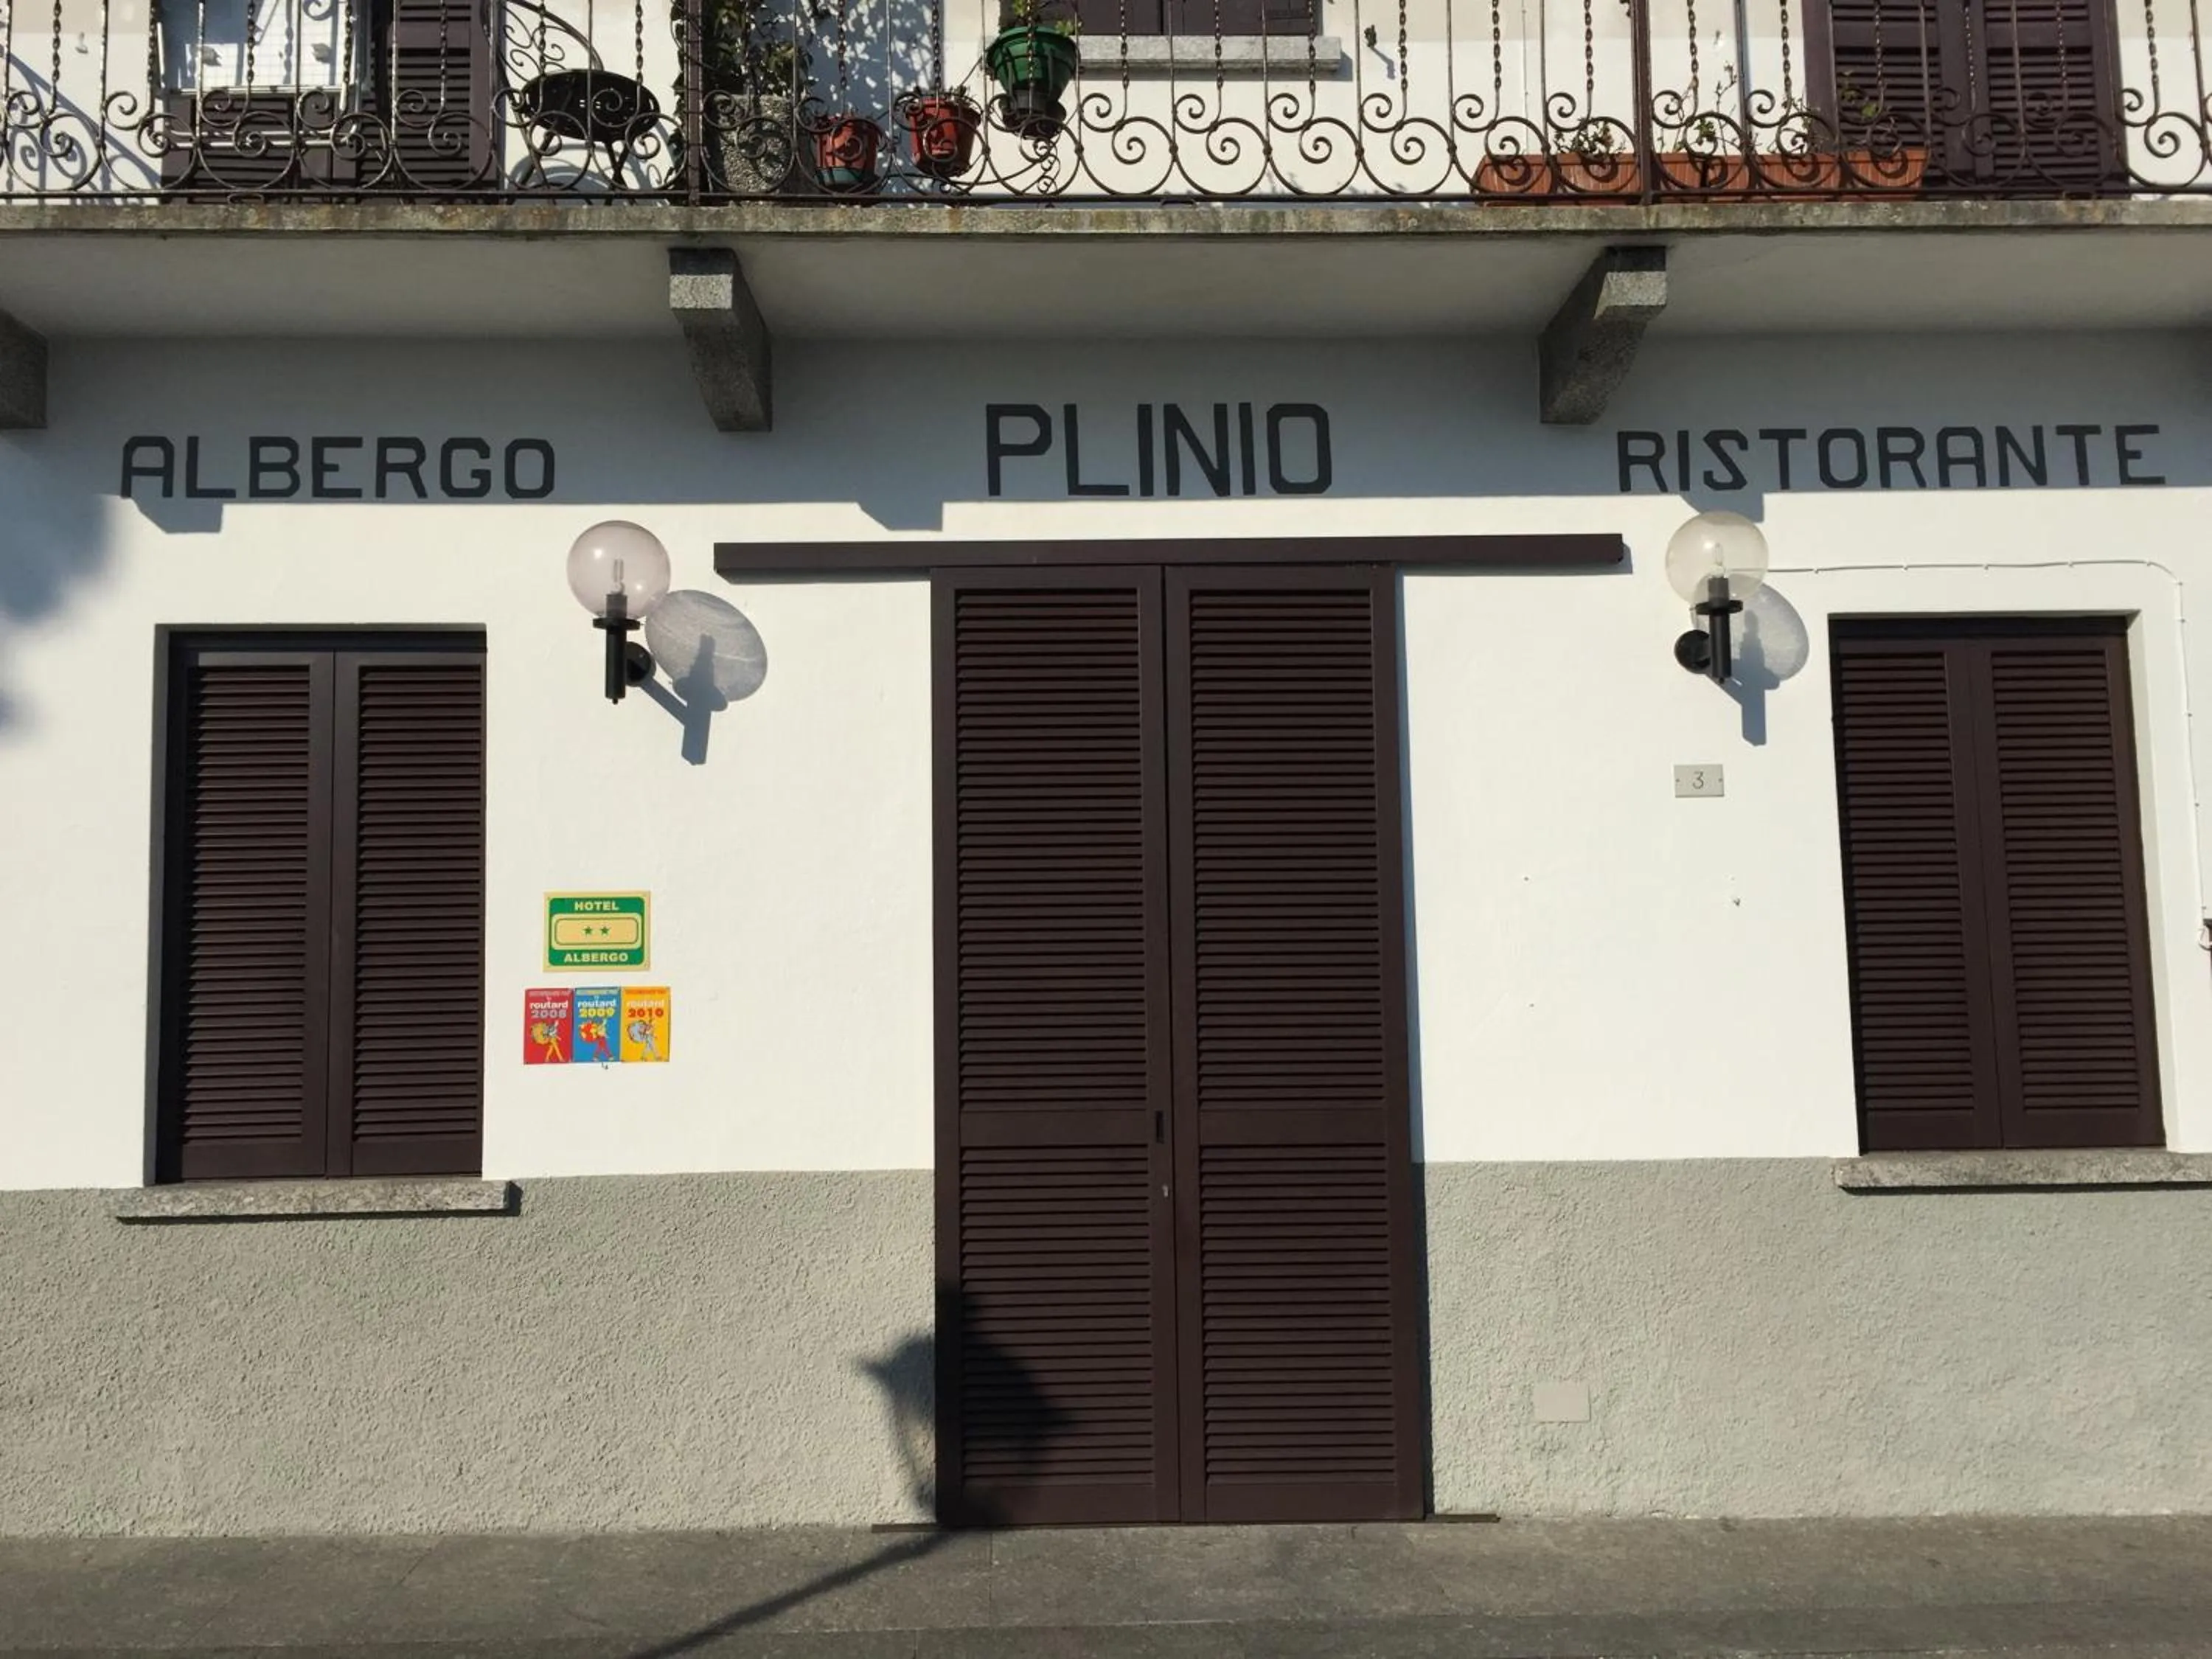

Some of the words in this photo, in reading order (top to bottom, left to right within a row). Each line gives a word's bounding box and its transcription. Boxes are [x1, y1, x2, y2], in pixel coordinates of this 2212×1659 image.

[986, 402, 1332, 497] PLINIO
[1616, 425, 2166, 493] RISTORANTE
[121, 436, 555, 499] ALBERGO
[1692, 771, 1704, 790] 3
[574, 901, 620, 911] HOTEL
[564, 952, 629, 963] ALBERGO
[529, 1000, 568, 1009] routard
[577, 998, 617, 1008] routard
[578, 1007, 615, 1018] 2009
[627, 1007, 664, 1018] 2010
